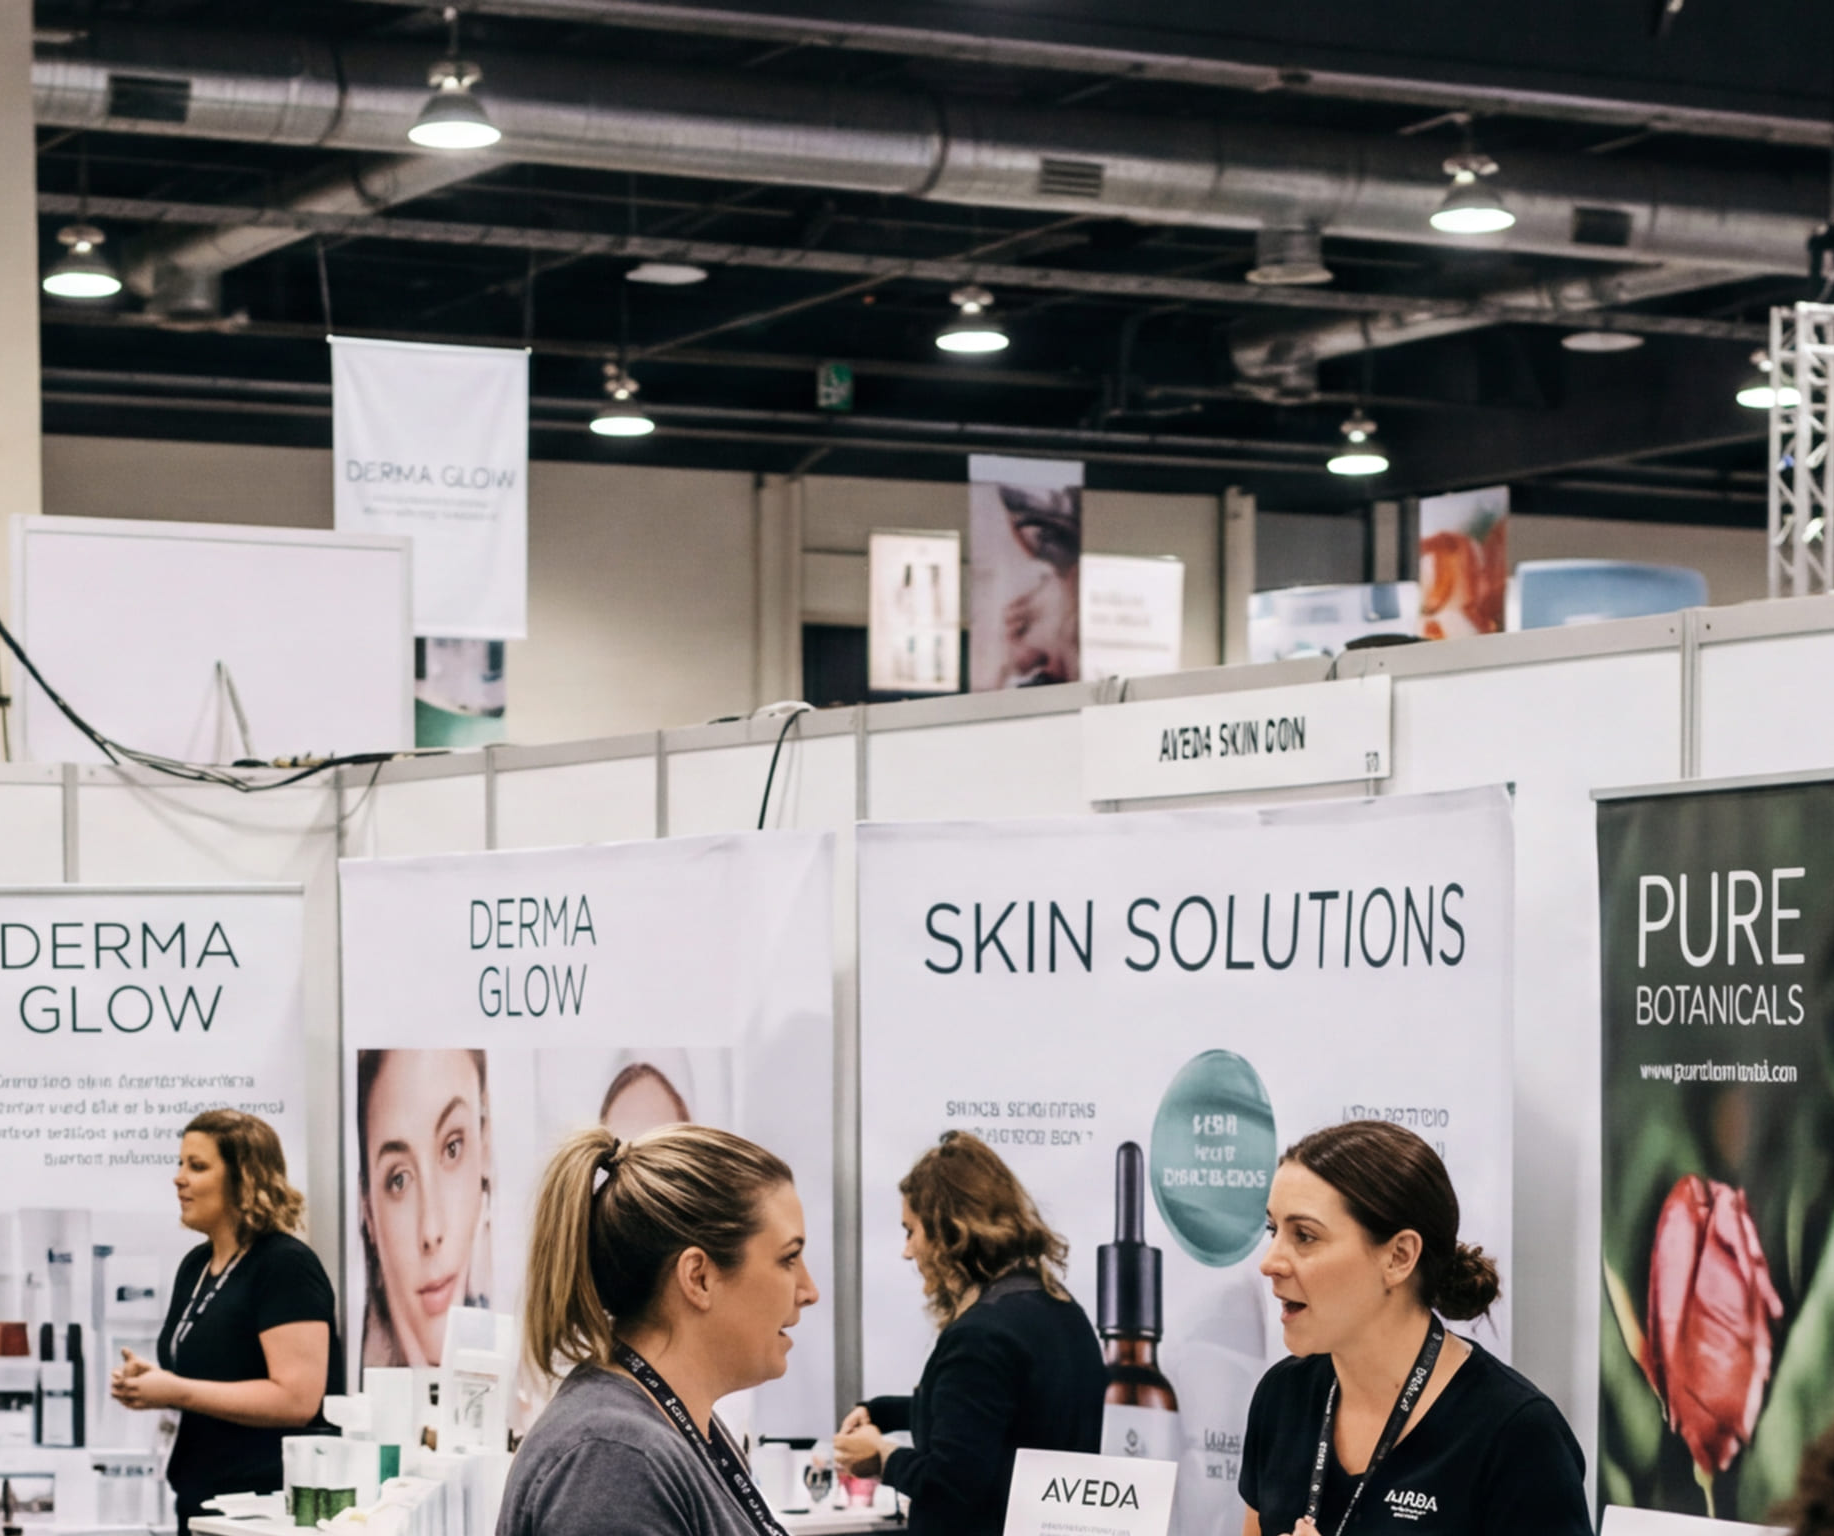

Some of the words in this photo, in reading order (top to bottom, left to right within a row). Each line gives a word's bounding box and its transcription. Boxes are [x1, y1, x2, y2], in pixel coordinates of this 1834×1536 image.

[346, 459, 434, 486] DERMA
[440, 465, 516, 490] GLOW
[469, 893, 597, 950] DERMA
[923, 899, 1095, 976] SKIN
[1123, 881, 1467, 973] SOLUTIONS
[1637, 866, 1807, 969] PURE
[0, 920, 241, 970] DERMA
[18, 984, 224, 1034] GLOW
[478, 963, 588, 1017] GLOW
[1635, 983, 1806, 1027] BOTANICALS
[1040, 1476, 1141, 1511] AVEDA
